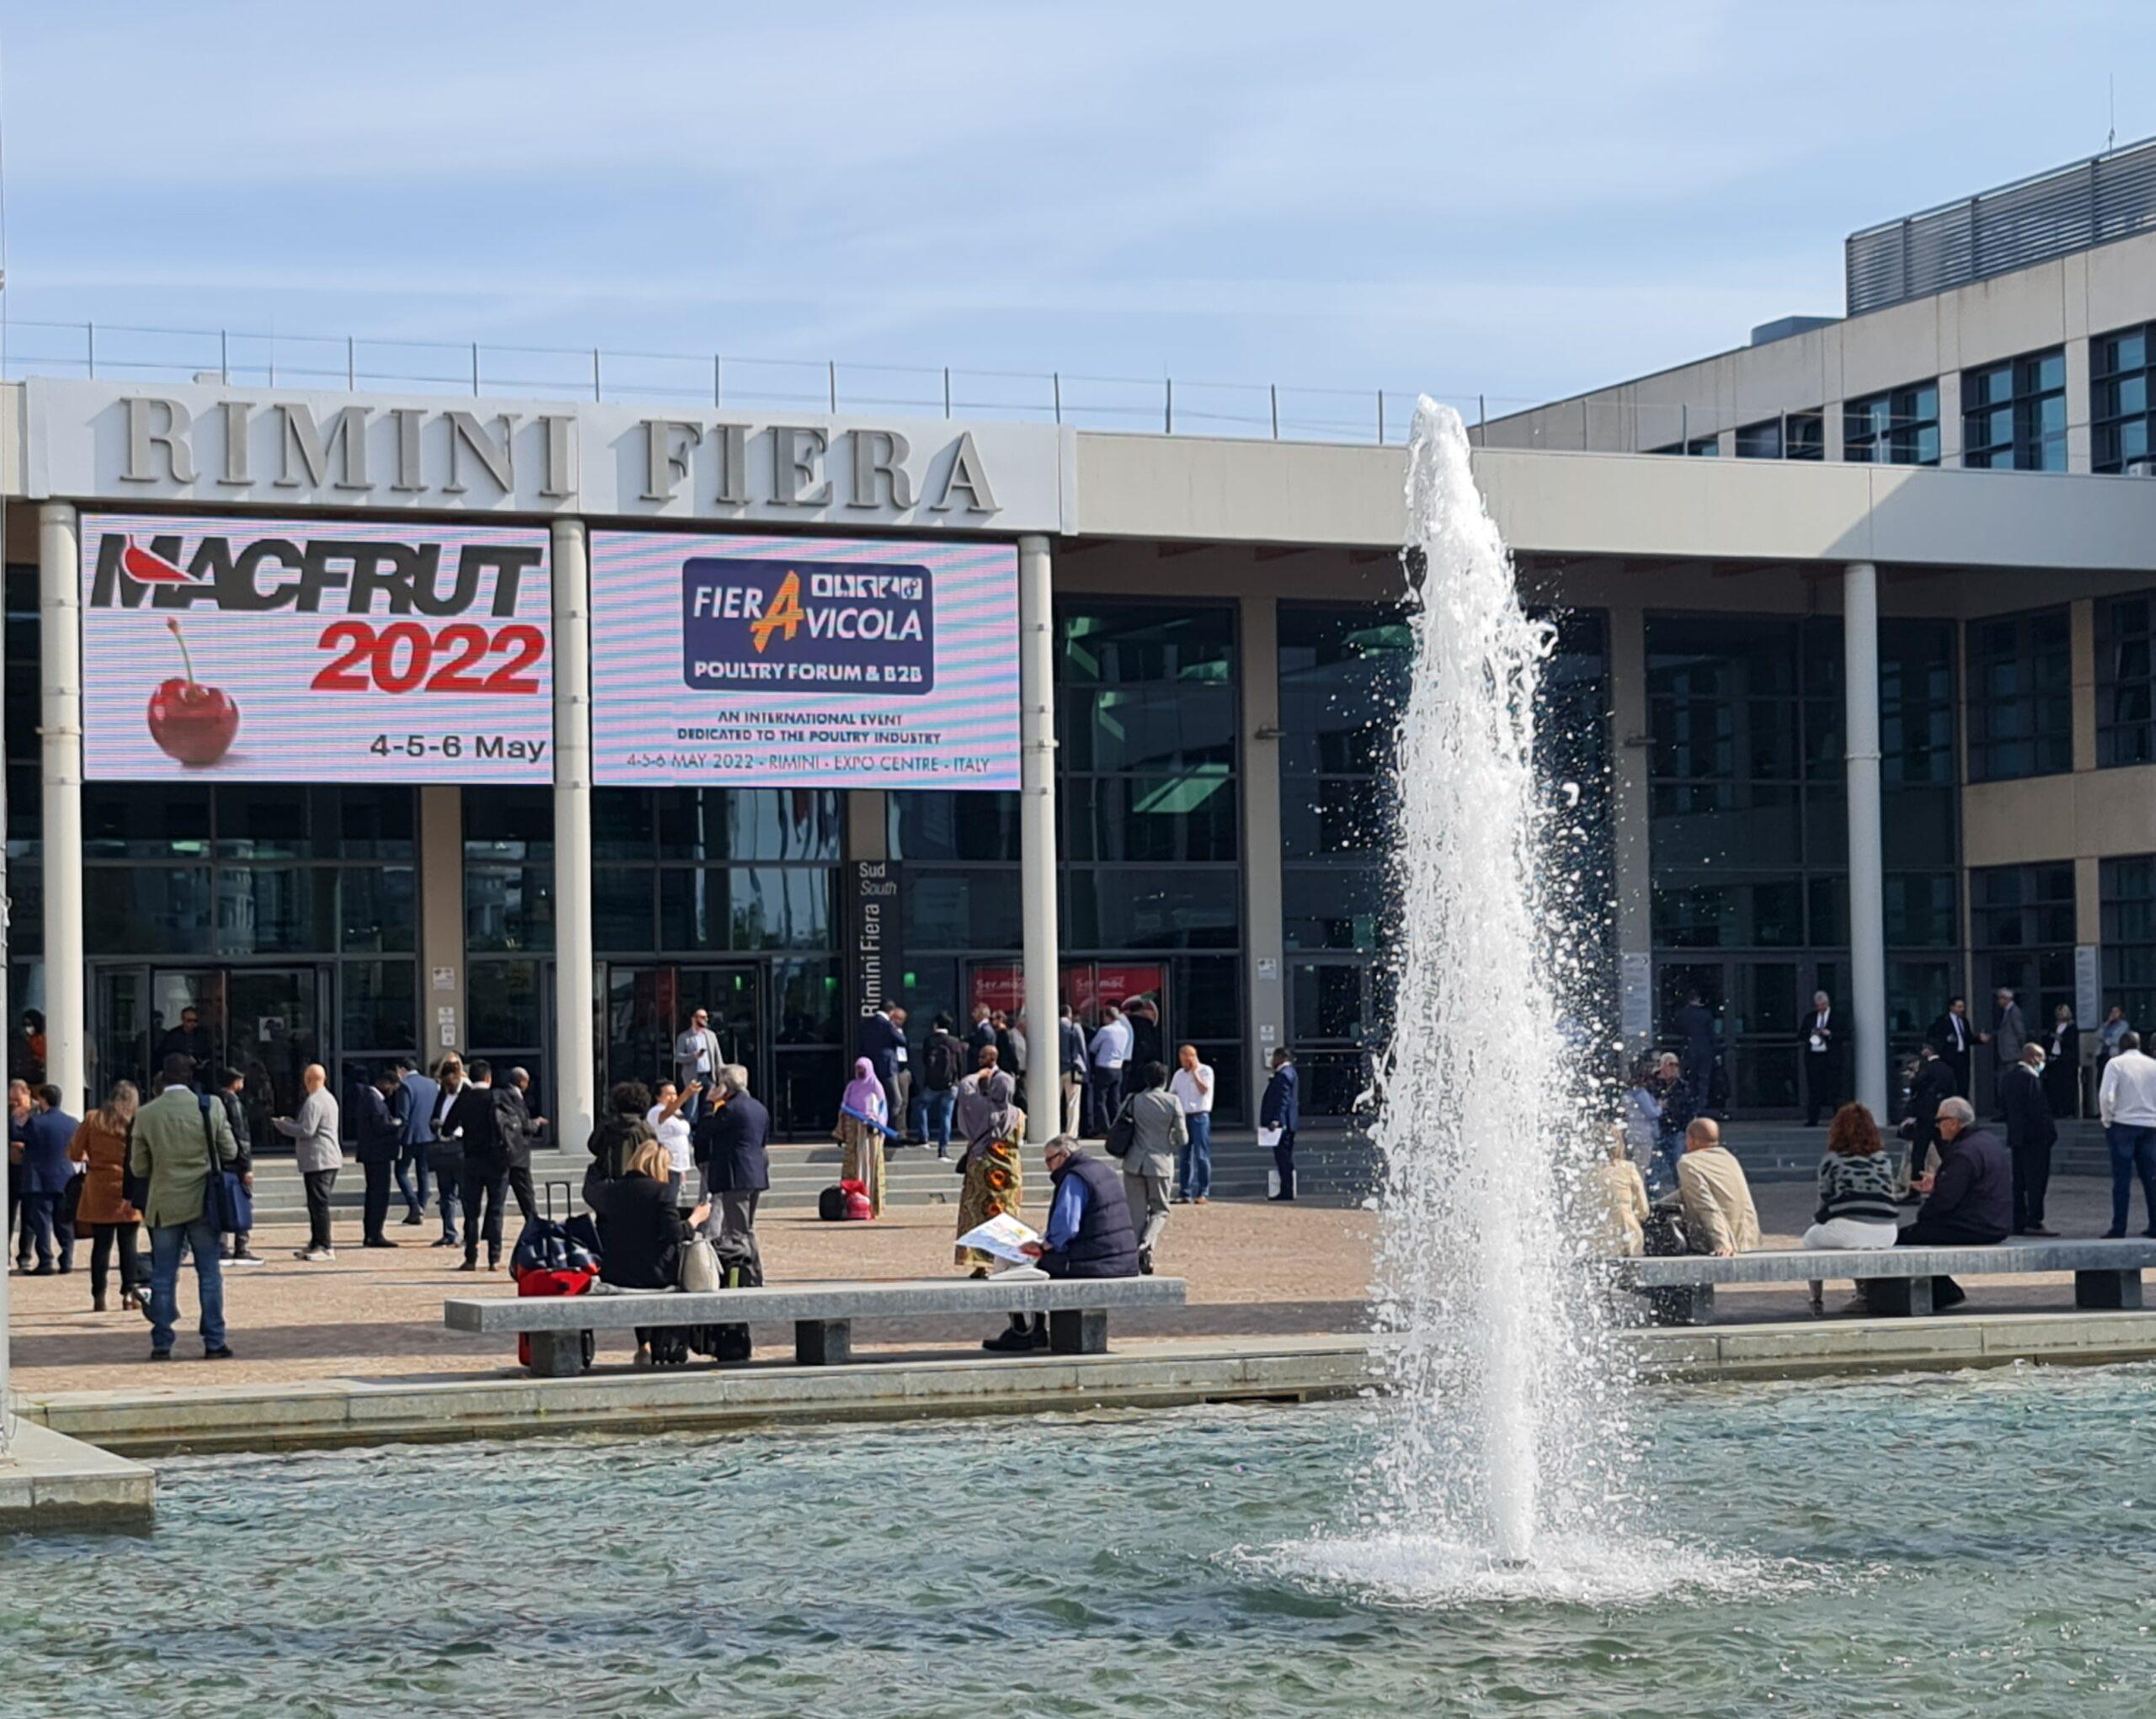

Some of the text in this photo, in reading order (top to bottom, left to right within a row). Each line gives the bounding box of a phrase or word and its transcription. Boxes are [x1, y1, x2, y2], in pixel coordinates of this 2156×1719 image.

[120, 398, 1003, 513] RIMINI FIERA
[90, 533, 543, 617] MACFRUT
[310, 621, 546, 694] 2022
[695, 661, 923, 683] POULTRY FORUM & B2B
[718, 711, 903, 726] AN INTERNATIONAL EVENT
[677, 728, 942, 745] DEDICATED TO THE POULTRY INDUSTRY
[370, 734, 546, 764] 4-5-6 May
[627, 753, 666, 768] 4-5-6
[671, 753, 707, 768] MAY
[713, 754, 754, 769] 2022
[769, 755, 819, 770] RIMINI
[835, 755, 875, 771] EXPO
[880, 756, 939, 772] CENTRE
[953, 758, 991, 772] ITALY
[859, 862, 886, 878] Sud
[860, 880, 898, 896] South
[860, 904, 882, 1018] Rimini Fiera
